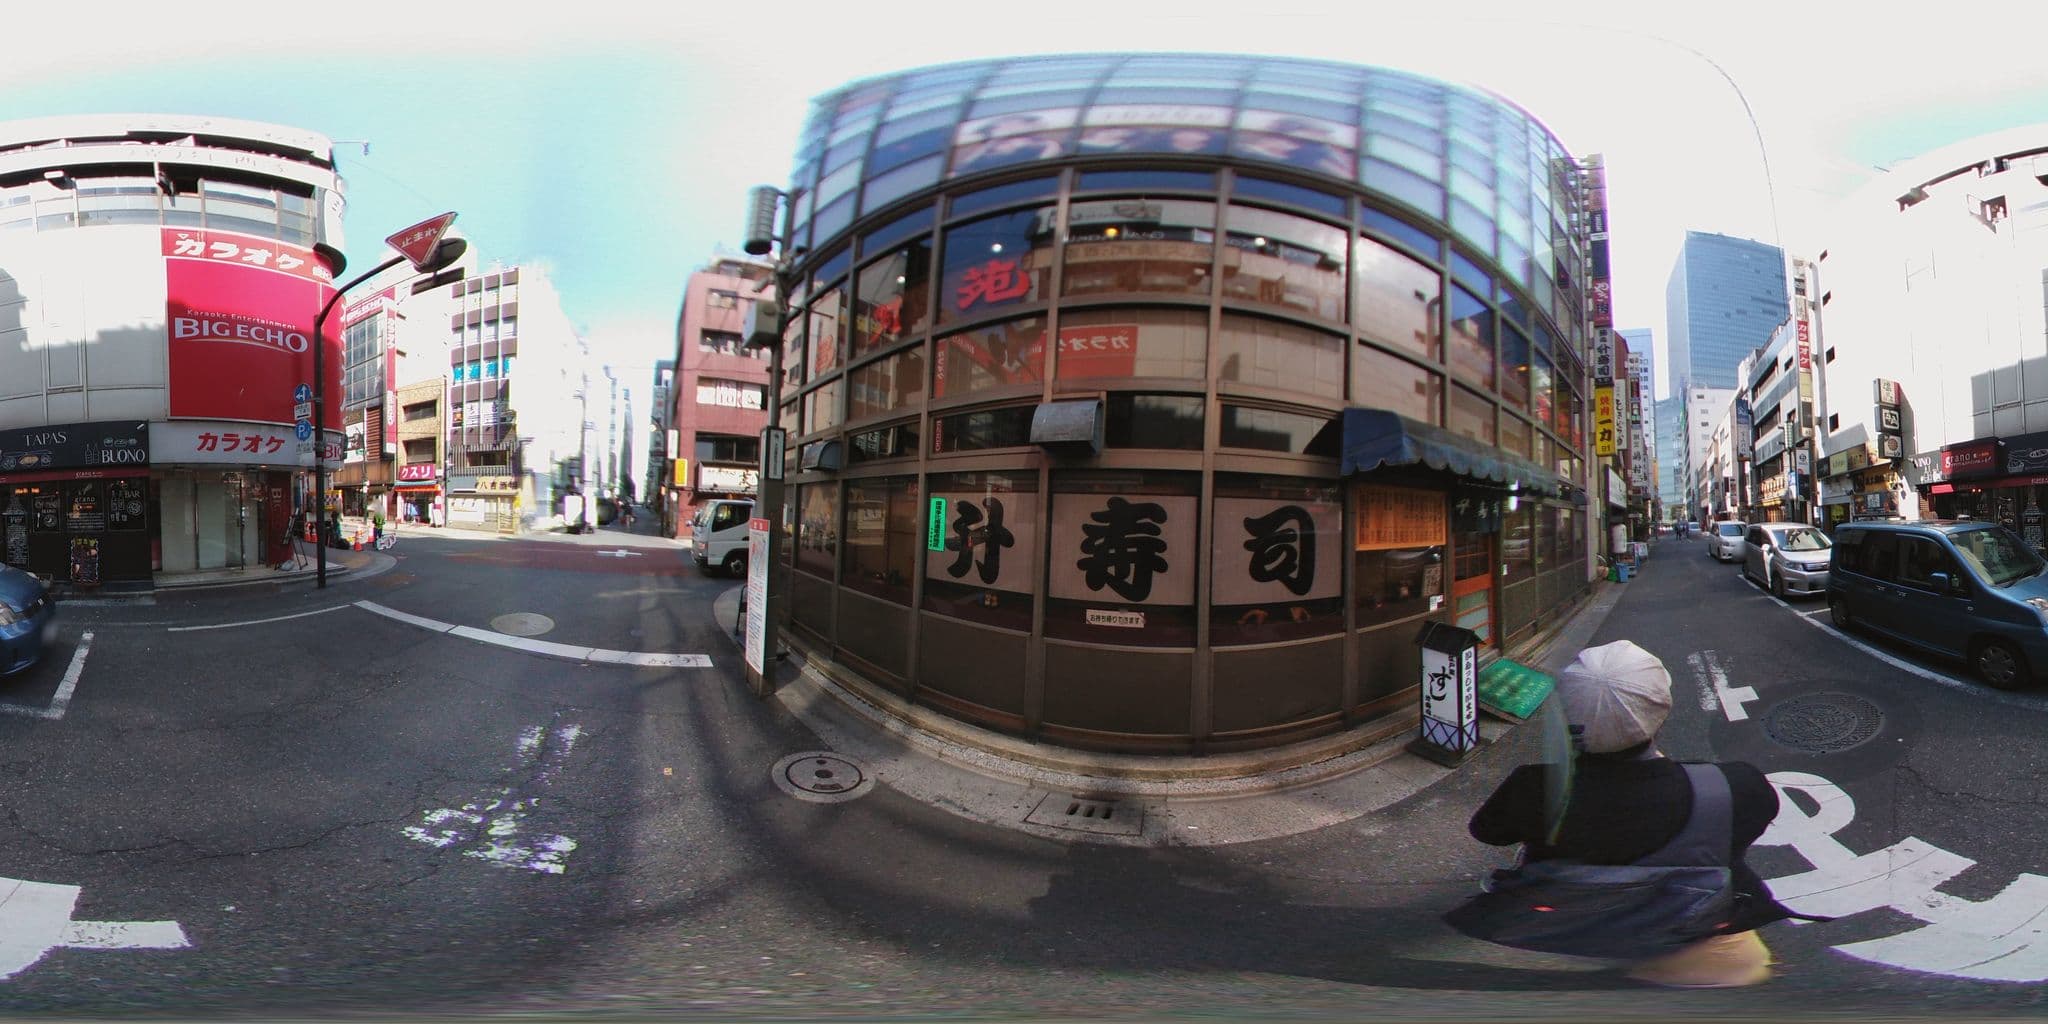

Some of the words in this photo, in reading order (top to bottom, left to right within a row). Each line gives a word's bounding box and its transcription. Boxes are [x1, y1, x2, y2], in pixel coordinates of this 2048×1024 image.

[400, 227, 438, 248] 止まれ
[174, 238, 304, 269] カラオケ
[187, 309, 227, 319] Karaoke
[231, 313, 297, 330] Entertainment
[175, 317, 230, 338] BIG
[236, 324, 308, 353] ECHO
[1798, 323, 1810, 367] カラオケ
[24, 431, 67, 446] TAPAS
[197, 433, 286, 454] カラオケ
[102, 449, 145, 464] BUONO
[1914, 457, 1931, 468] VINO
[1945, 452, 1971, 469] grano
[402, 465, 431, 479] クスリ
[125, 490, 141, 498] BAR
[1428, 666, 1452, 701] すし
